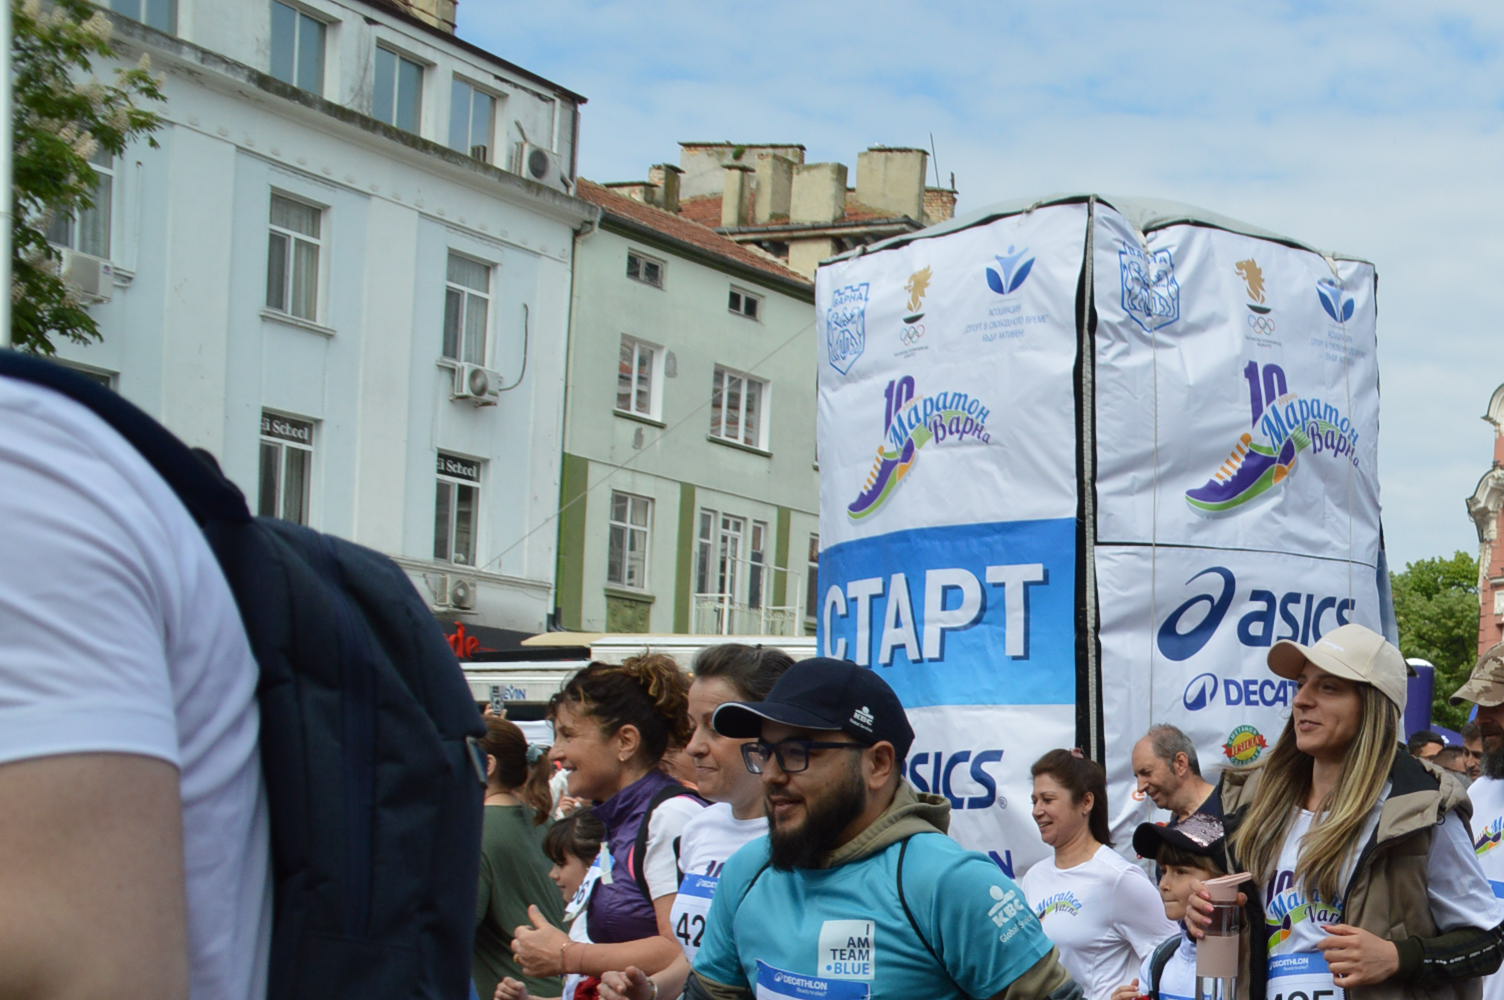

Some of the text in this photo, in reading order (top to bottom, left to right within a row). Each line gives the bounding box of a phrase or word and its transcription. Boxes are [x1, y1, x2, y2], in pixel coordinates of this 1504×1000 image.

[889, 391, 991, 451] Маратон
[929, 413, 991, 444] Варна
[1261, 397, 1359, 452] Маратон
[1307, 420, 1360, 468] Варна
[823, 562, 1047, 668] СТАРТ
[992, 898, 1025, 928] KBC
[830, 949, 870, 961] TEAM
[847, 936, 870, 948] AM
[783, 974, 828, 990] DECATHLON
[833, 962, 871, 975] BLUE
